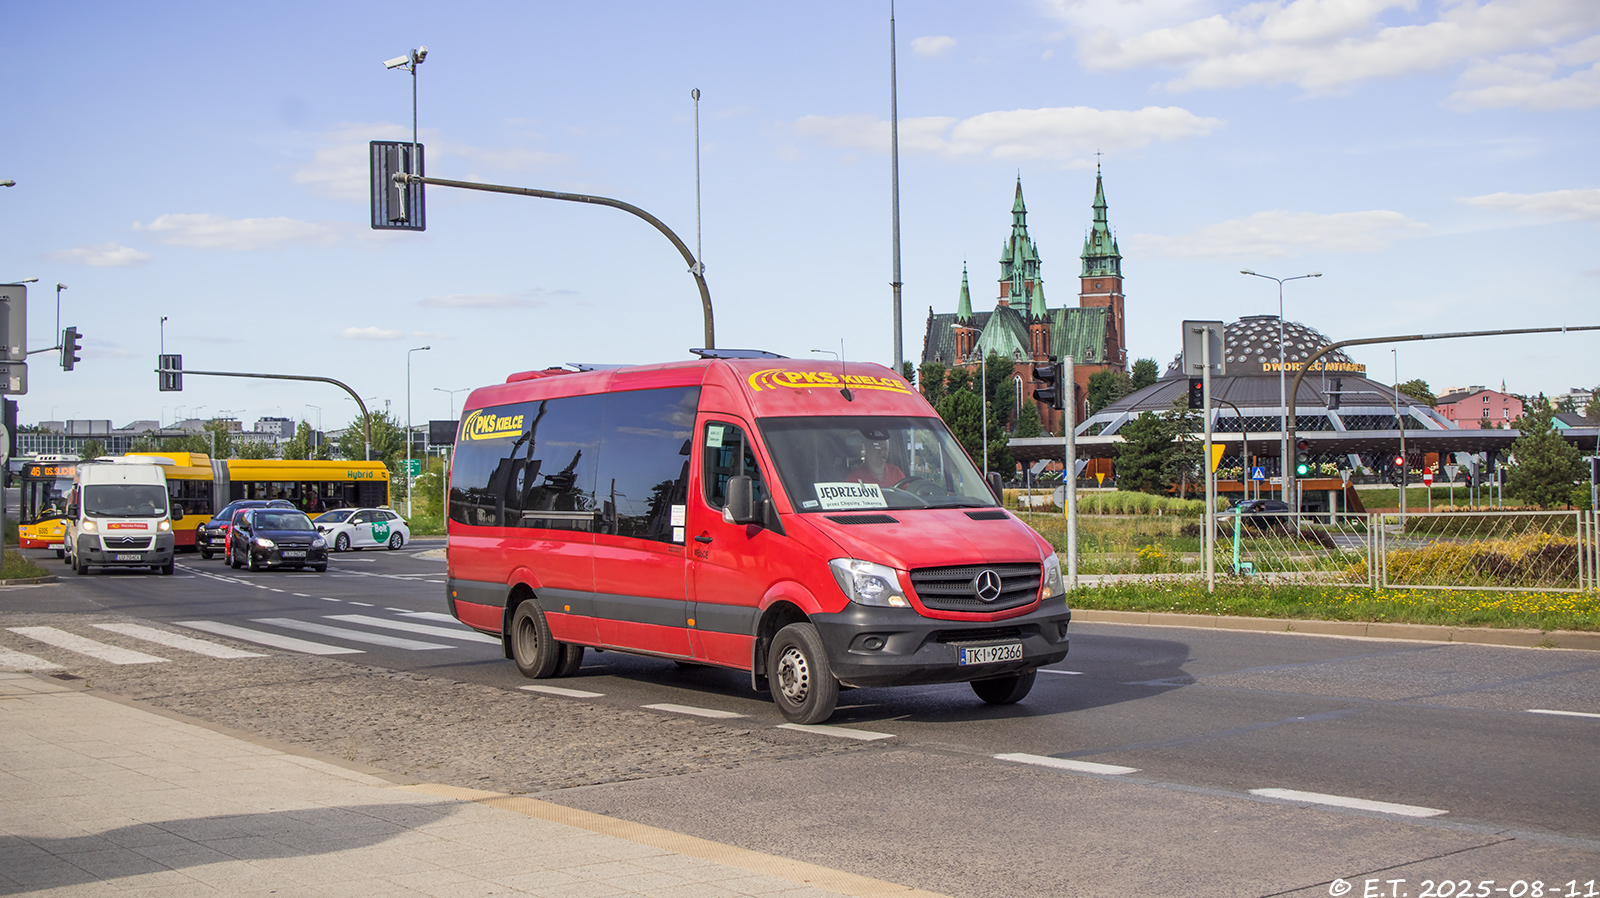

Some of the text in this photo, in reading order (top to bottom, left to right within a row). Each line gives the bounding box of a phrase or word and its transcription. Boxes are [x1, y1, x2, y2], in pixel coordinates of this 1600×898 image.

[786, 371, 907, 390] PKS KIELCE
[475, 413, 524, 434] PKS KIELCE
[30, 466, 41, 477] 46
[347, 470, 374, 480] Hybrid
[374, 523, 388, 533] Bolt
[991, 645, 1021, 661] 92366
